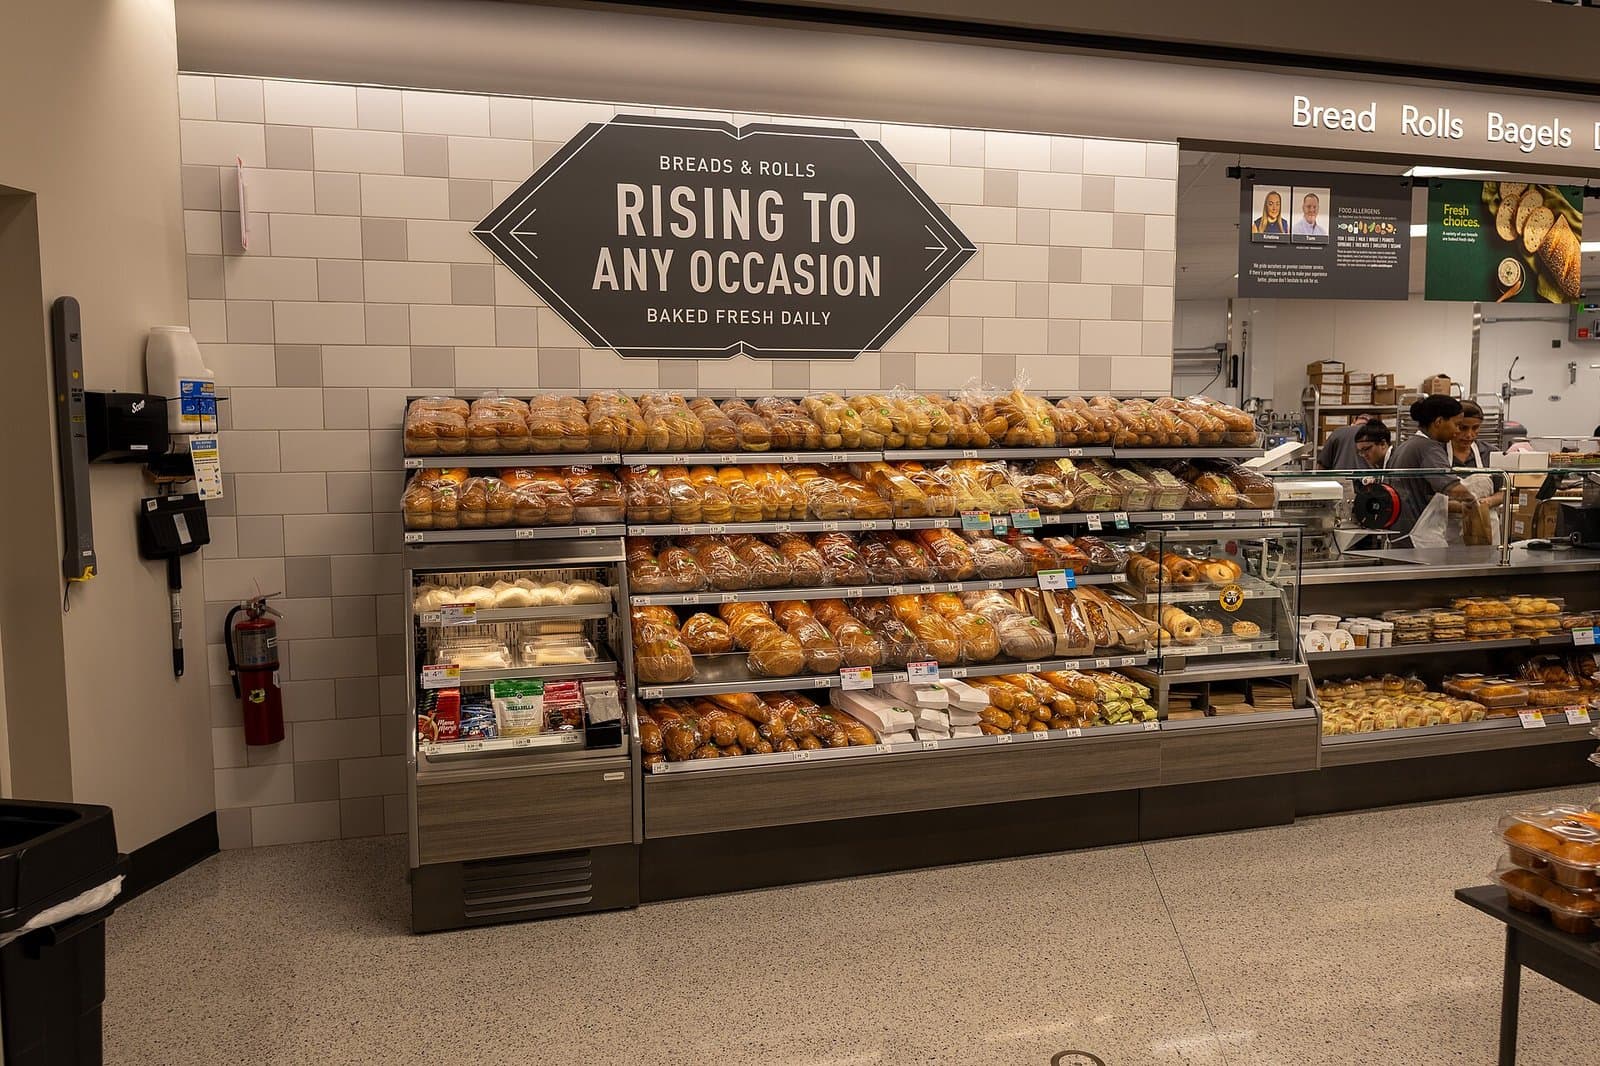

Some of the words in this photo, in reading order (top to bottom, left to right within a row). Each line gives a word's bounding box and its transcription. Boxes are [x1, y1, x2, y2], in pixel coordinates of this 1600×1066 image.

[1292, 95, 1377, 133] Bread
[1402, 104, 1465, 140] Rolls
[1486, 112, 1573, 153] Bagels
[659, 154, 734, 176] BREADS
[740, 159, 754, 176] &
[758, 160, 817, 179] ROLLS
[615, 182, 785, 243] RISING
[802, 191, 858, 245] TO
[1443, 203, 1469, 216] Fresh
[1443, 214, 1480, 228] choices.
[591, 246, 675, 292] ANY
[689, 249, 882, 297] OCCASION
[646, 307, 710, 325] BAKED
[714, 308, 775, 327] FRESH
[780, 309, 832, 327] DAILY
